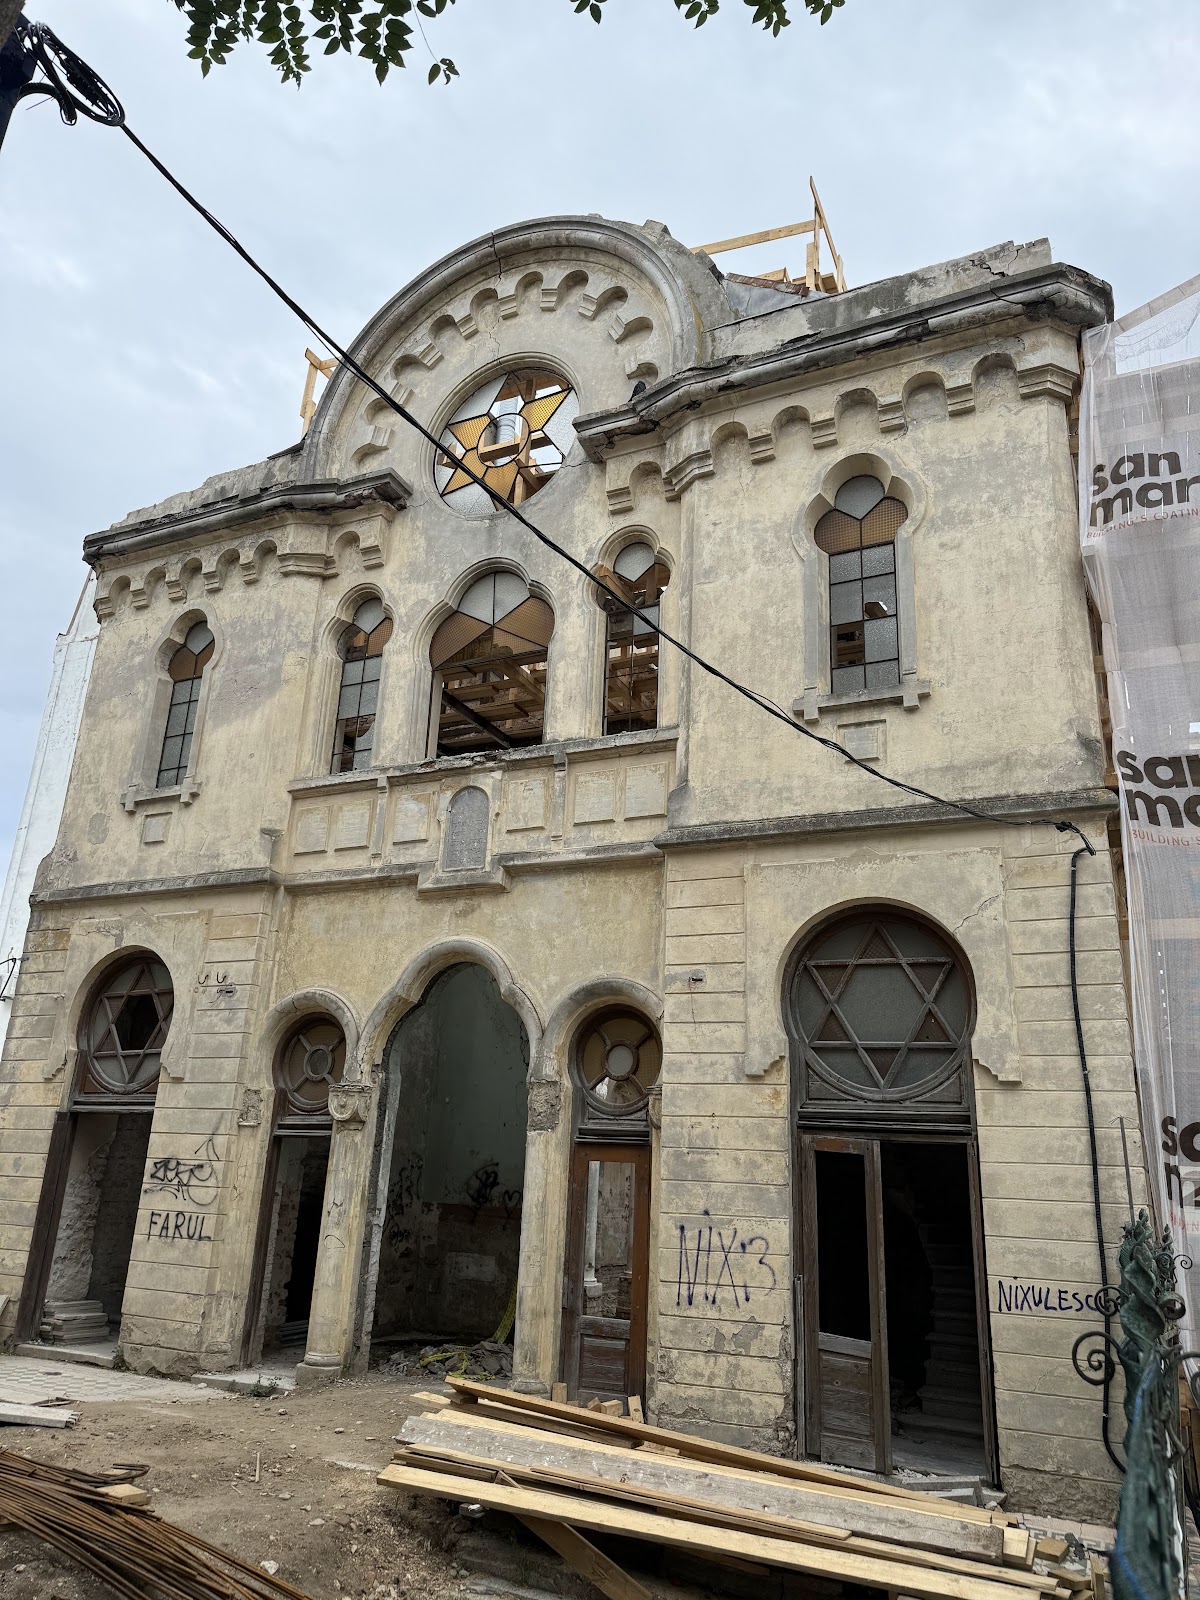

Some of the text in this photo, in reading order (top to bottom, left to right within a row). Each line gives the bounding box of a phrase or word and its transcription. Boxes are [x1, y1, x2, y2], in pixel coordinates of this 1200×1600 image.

[1092, 451, 1182, 497] san
[1153, 507, 1200, 521] COATIN
[147, 1211, 212, 1241] FARUL
